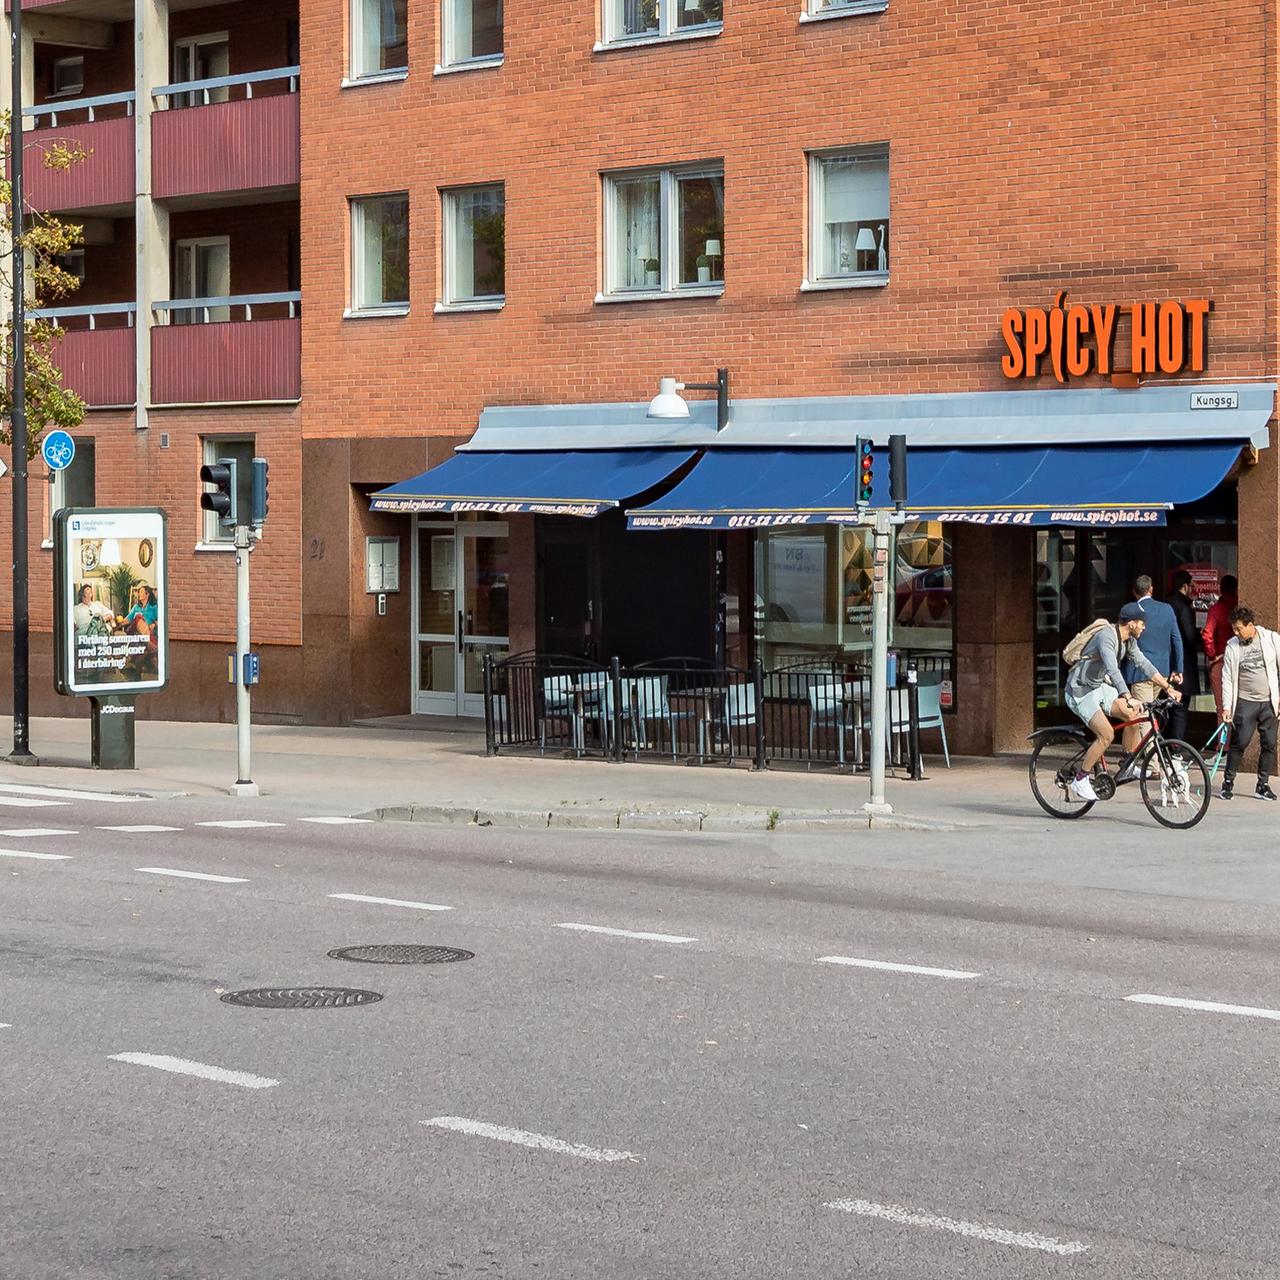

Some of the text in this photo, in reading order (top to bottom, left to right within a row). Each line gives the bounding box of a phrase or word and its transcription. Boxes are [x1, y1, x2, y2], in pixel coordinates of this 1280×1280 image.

[1001, 290, 1213, 383] SPICY HOT
[1196, 394, 1236, 408] Kungsg.
[632, 514, 714, 528] www.spicyhot.se
[991, 512, 1012, 524] 15
[1013, 512, 1034, 524] 01
[1050, 509, 1158, 525] www.spicyhot.se
[78, 646, 96, 657] med
[97, 646, 112, 656] 250
[100, 704, 135, 714] JCDecaux
